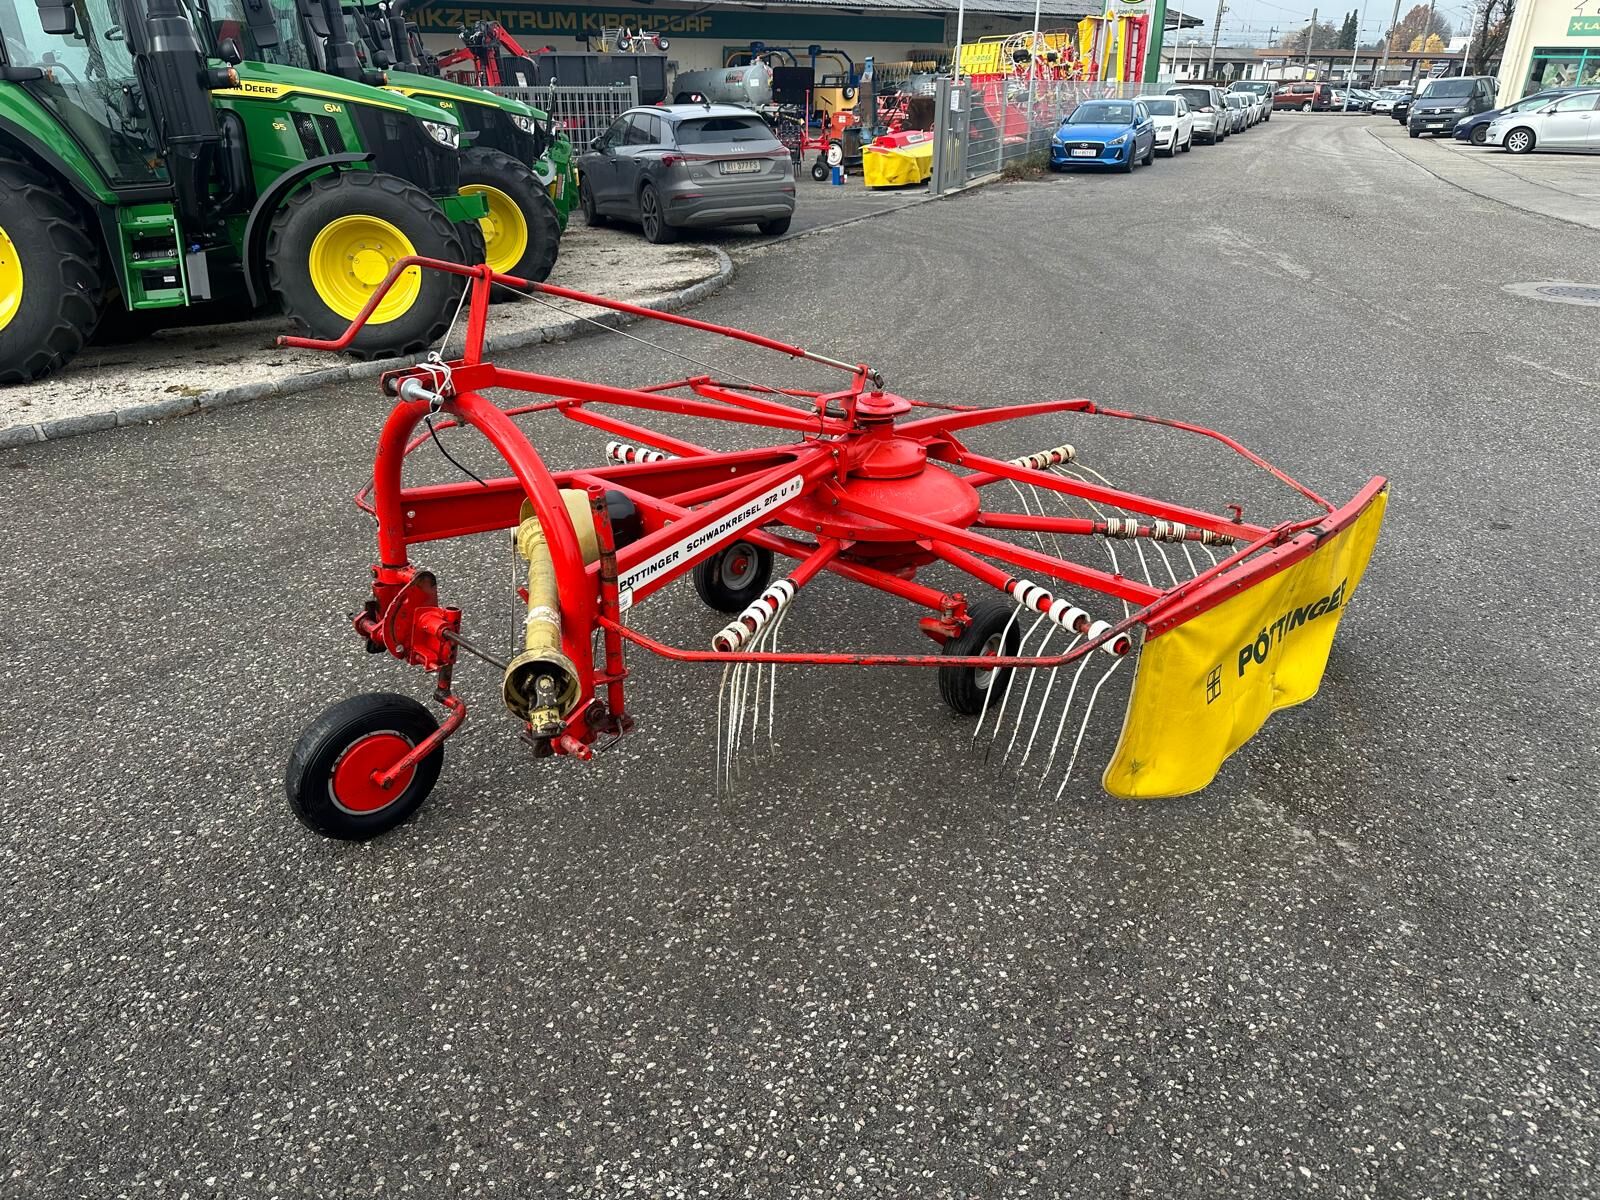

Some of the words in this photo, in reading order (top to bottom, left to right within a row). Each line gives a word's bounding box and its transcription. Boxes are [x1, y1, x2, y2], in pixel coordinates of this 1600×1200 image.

[582, 12, 713, 33] KIRCHDORF
[245, 83, 278, 94] DEERE
[323, 103, 342, 113] 6M
[272, 122, 287, 131] 95
[619, 550, 679, 592] PÖTTINGER
[686, 503, 762, 553] SCHWADKREISEL
[764, 493, 778, 507] 272
[781, 487, 788, 497] U
